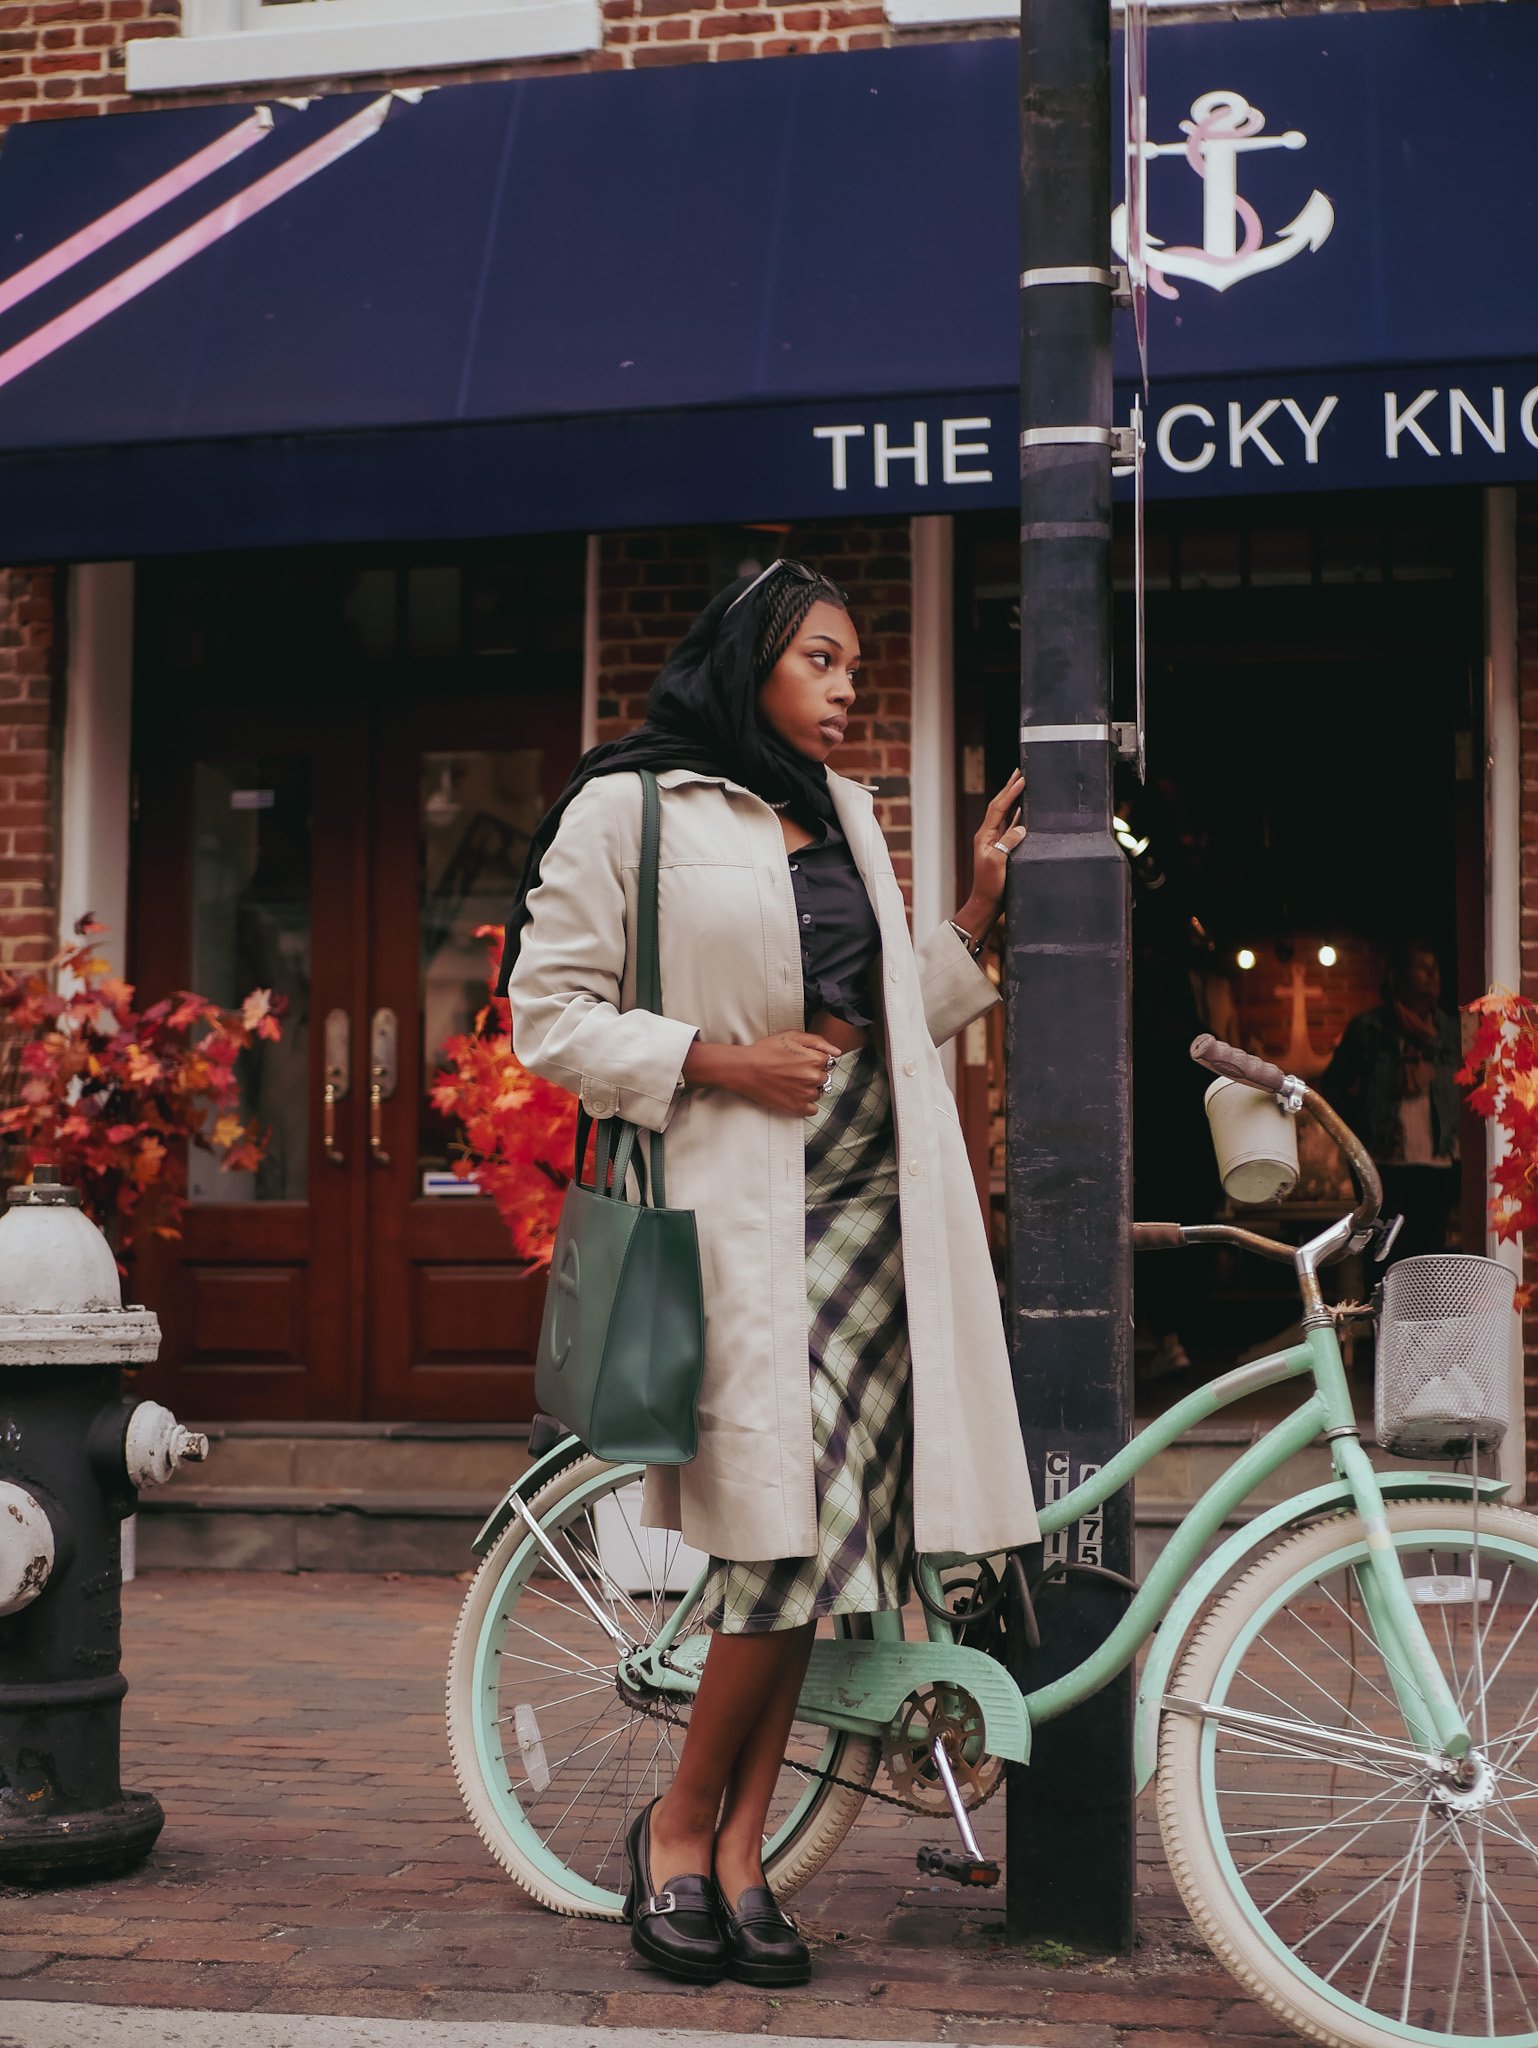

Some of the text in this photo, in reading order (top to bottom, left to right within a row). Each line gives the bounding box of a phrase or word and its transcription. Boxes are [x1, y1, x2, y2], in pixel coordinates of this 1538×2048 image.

[813, 385, 1538, 490] THE CKY KN
